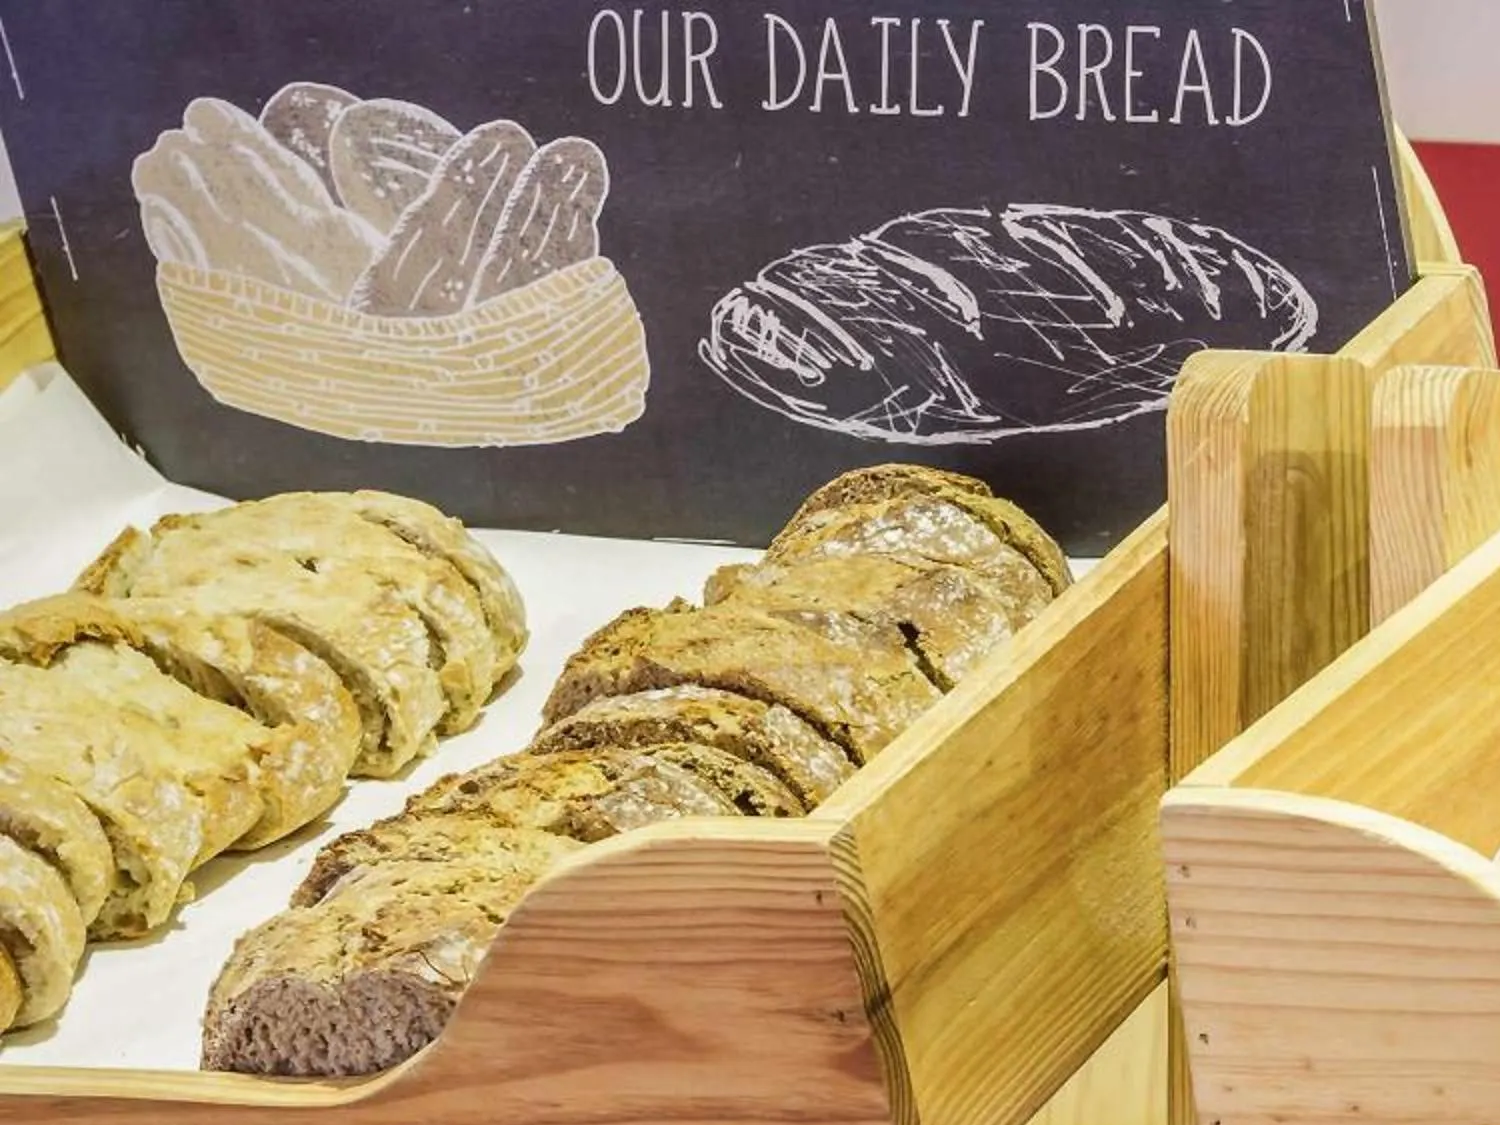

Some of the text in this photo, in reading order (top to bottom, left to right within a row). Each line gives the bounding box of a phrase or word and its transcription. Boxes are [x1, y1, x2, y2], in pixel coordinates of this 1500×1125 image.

[587, 8, 1272, 127] OUR DAILY BREAD
